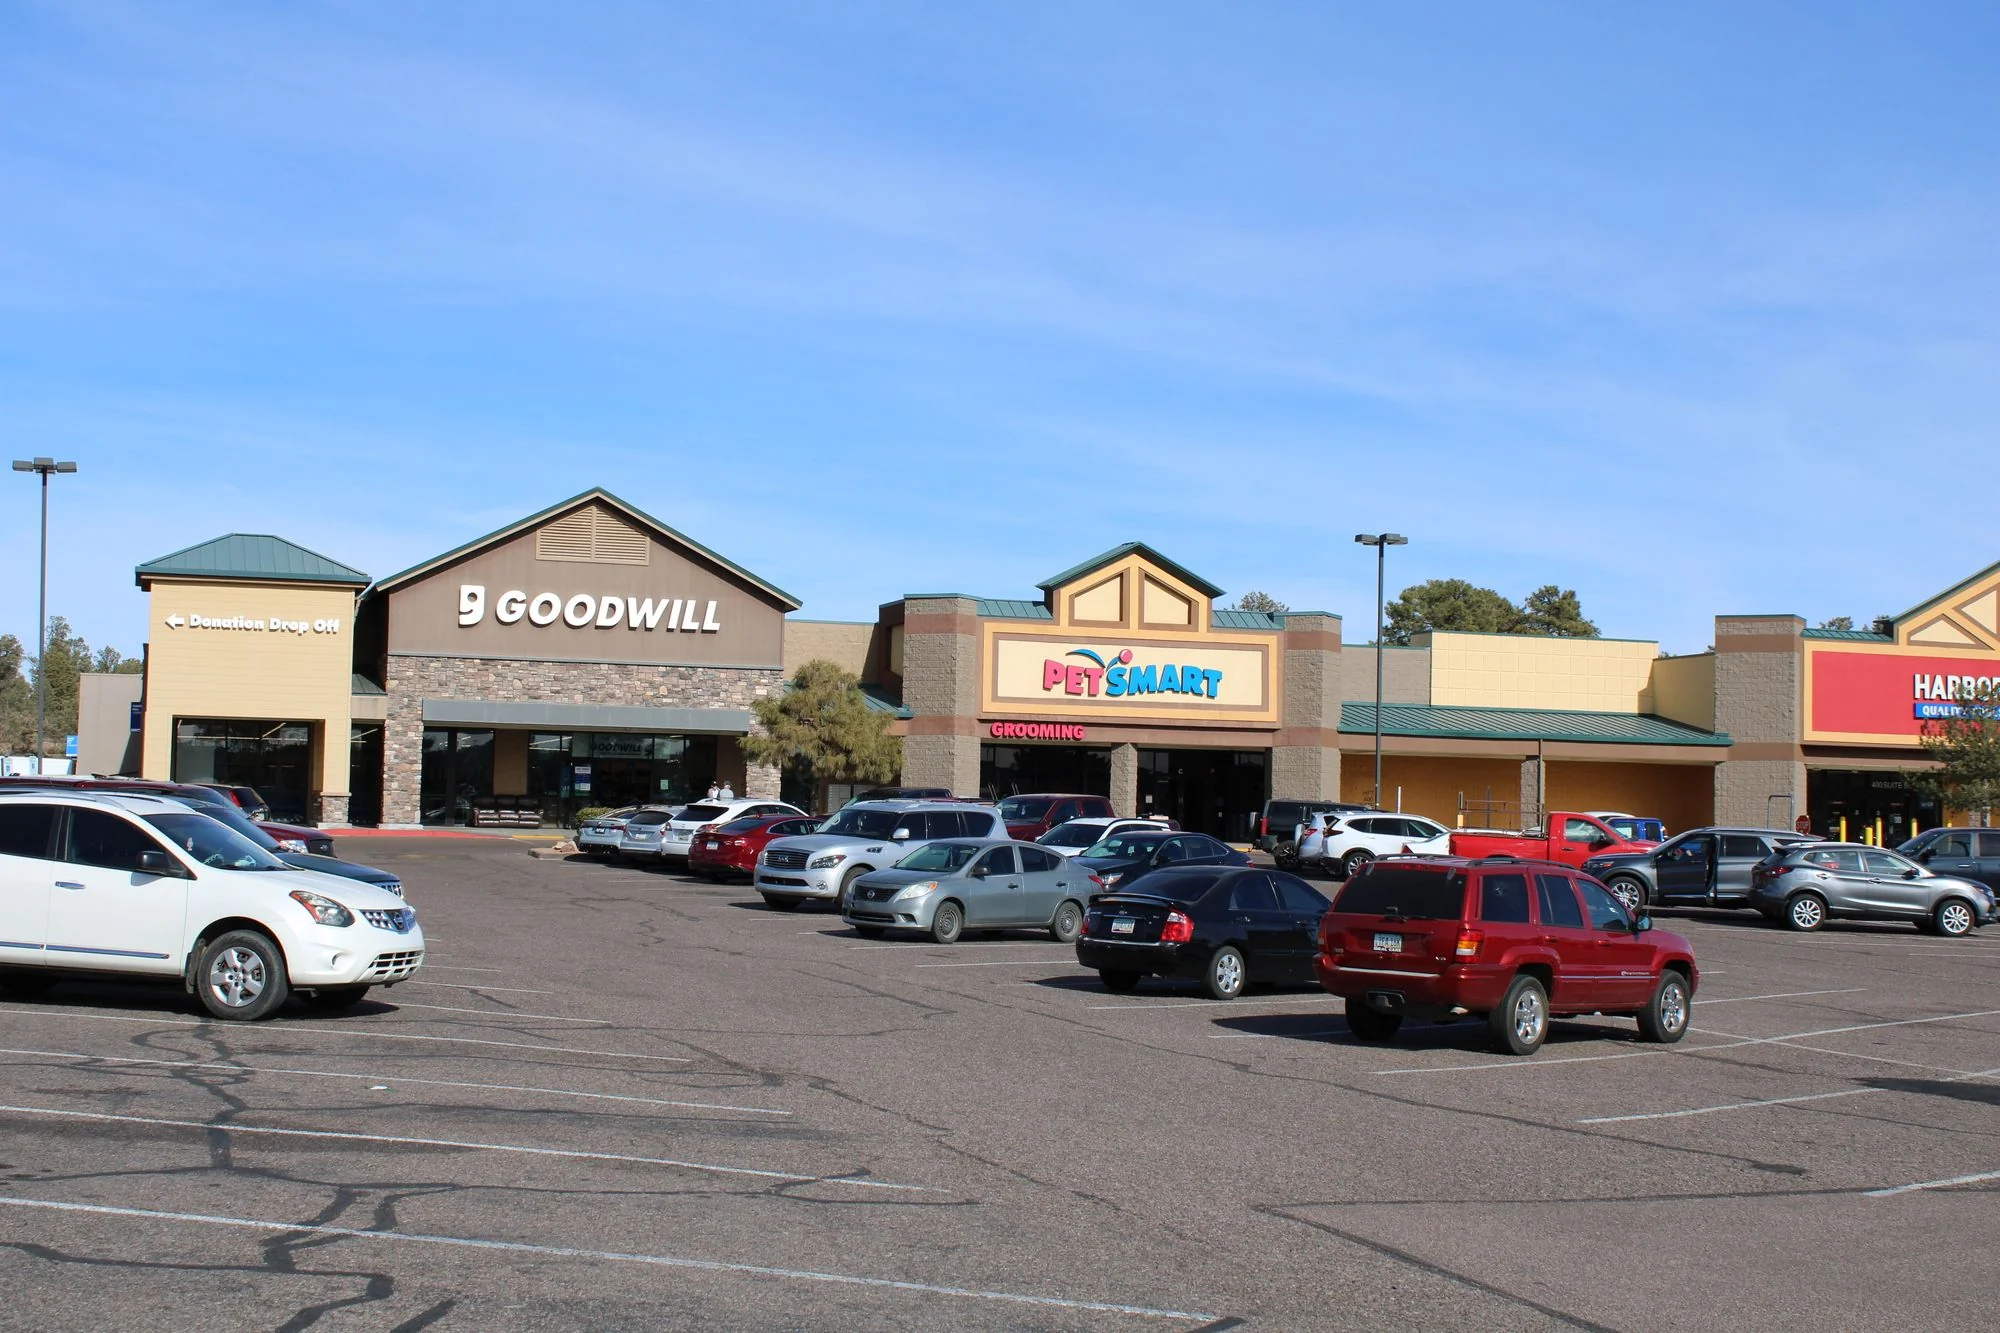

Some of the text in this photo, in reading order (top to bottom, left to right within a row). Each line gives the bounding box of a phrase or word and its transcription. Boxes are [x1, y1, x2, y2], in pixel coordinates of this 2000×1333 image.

[496, 590, 721, 632] GOODWILL
[189, 614, 340, 636] Donation Drop Off
[1043, 657, 1223, 699] PETSMART
[1922, 705, 1967, 717] QUALIT
[990, 722, 1085, 740] GROOMING
[1796, 821, 1809, 830] STOP
